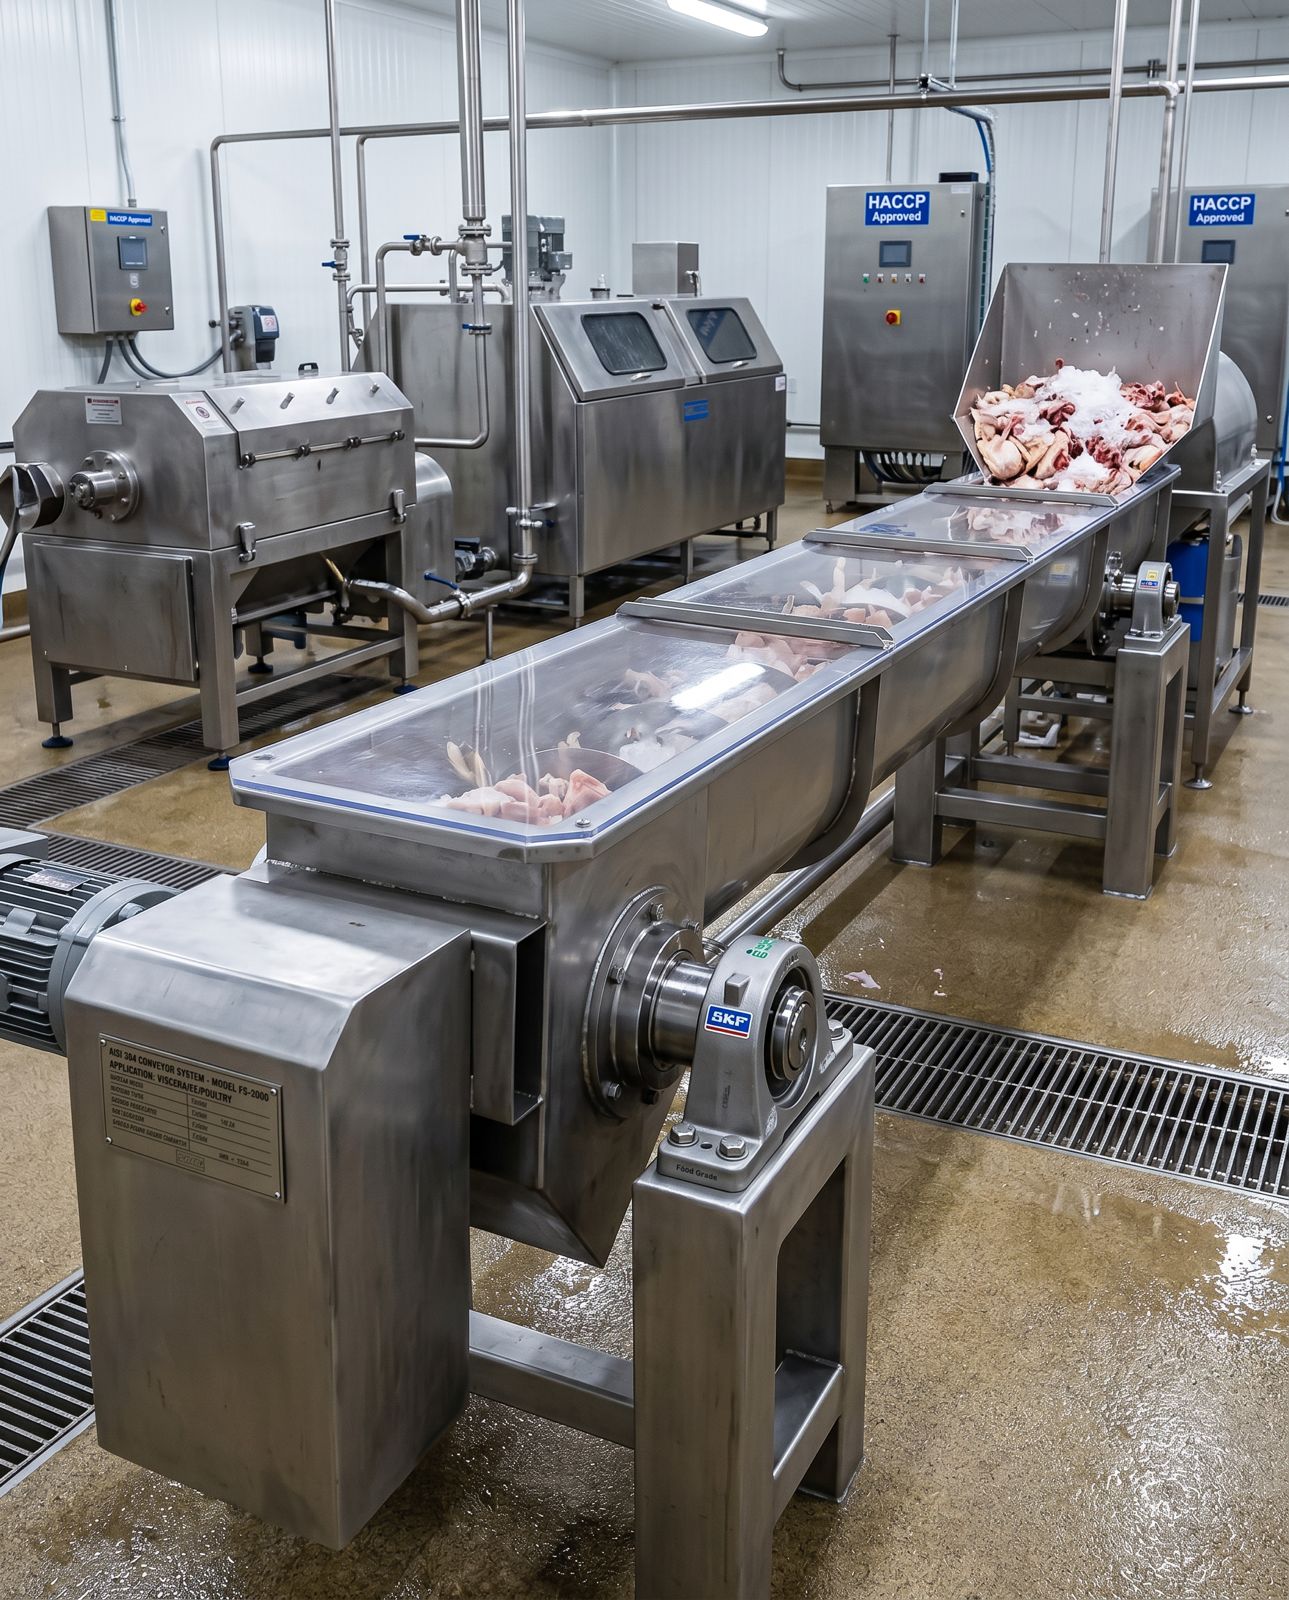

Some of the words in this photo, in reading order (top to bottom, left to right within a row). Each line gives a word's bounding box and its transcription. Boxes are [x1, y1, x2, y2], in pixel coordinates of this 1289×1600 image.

[868, 194, 926, 209] HACCP
[1193, 196, 1252, 211] HACCP
[872, 211, 922, 224] Approved
[1195, 212, 1245, 224] Approved
[711, 1010, 748, 1027] SKF
[109, 1060, 156, 1081] APPLICATION:
[109, 1047, 123, 1057] AISI
[124, 1051, 137, 1063] 304
[138, 1055, 175, 1074] CONVEYOR
[176, 1067, 204, 1083] SYSTEM
[211, 1077, 237, 1093] MODEL
[238, 1085, 269, 1102] FS-2000
[676, 1163, 694, 1175] Food
[695, 1169, 718, 1181] Grade
